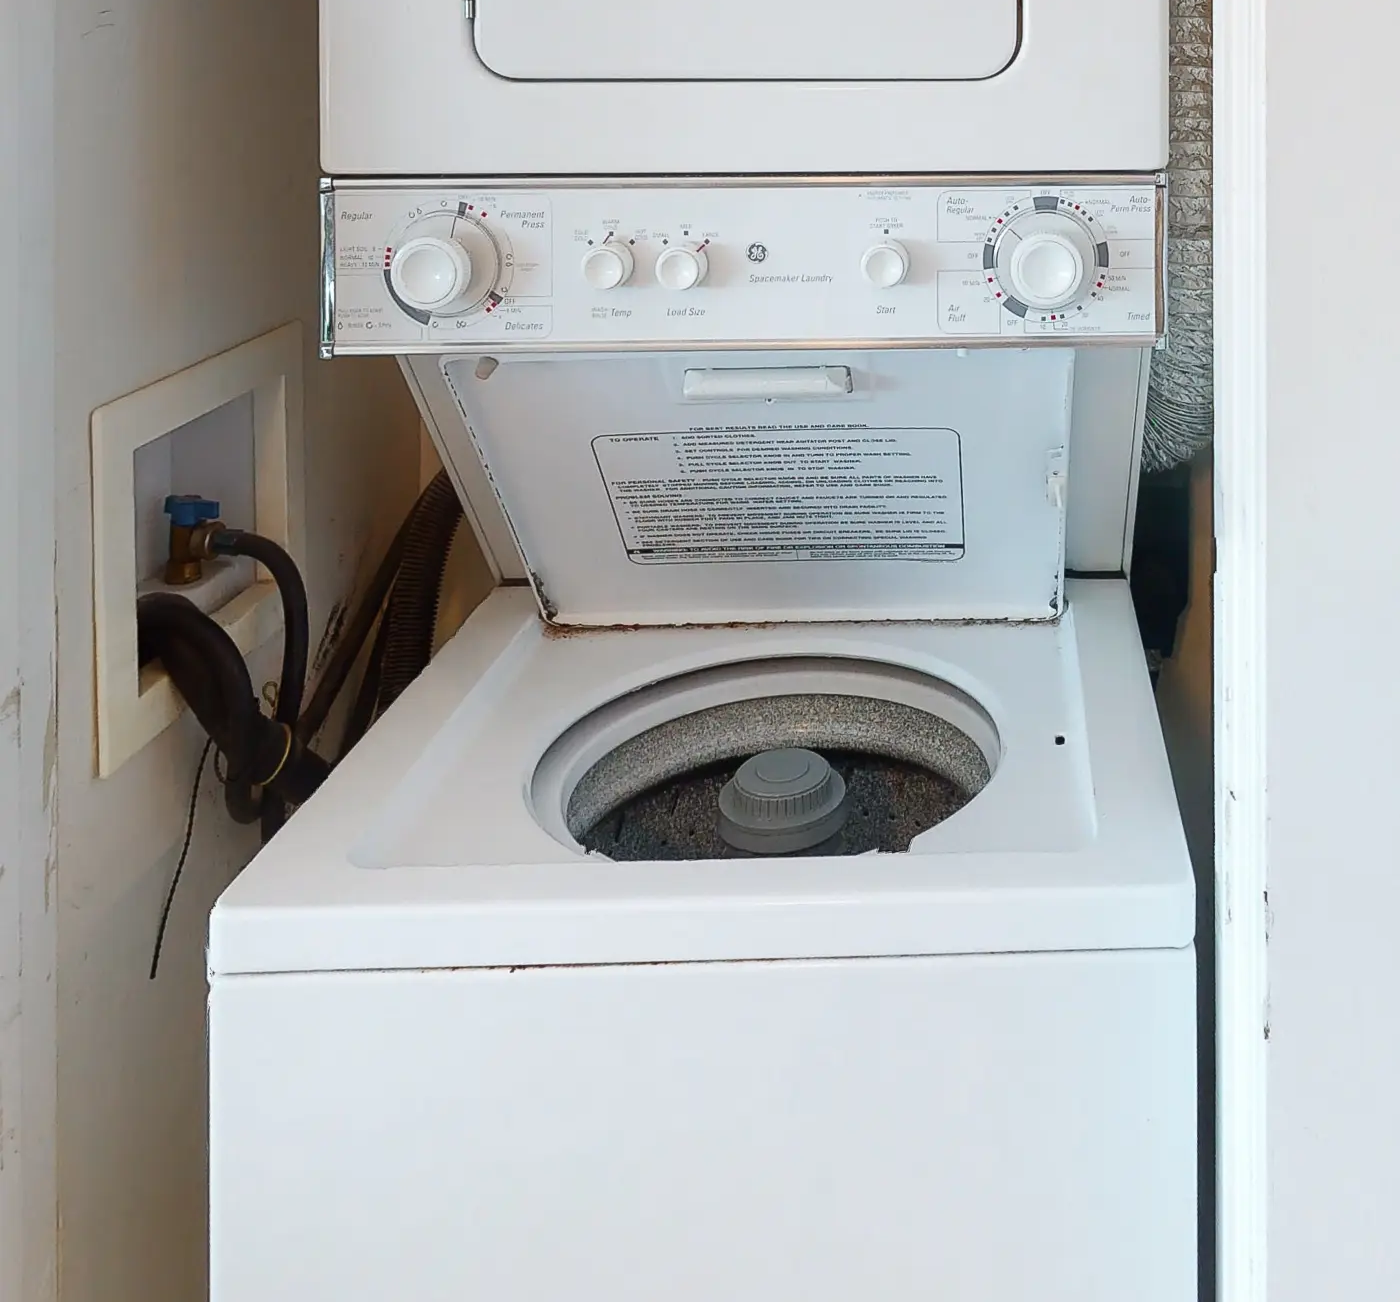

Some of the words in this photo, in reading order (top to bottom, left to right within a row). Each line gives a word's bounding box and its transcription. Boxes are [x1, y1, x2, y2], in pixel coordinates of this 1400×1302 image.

[946, 196, 969, 205] Auto-
[1129, 195, 1151, 204] Auto-
[946, 206, 974, 215] Regular
[1111, 205, 1130, 213] Perm
[1130, 205, 1151, 213] Press
[341, 211, 373, 222] Regular
[500, 210, 544, 219] Permanent
[521, 220, 544, 229] Press
[750, 274, 800, 283] Spacemaker
[801, 274, 833, 283] Laundry
[667, 307, 687, 317] Load
[688, 307, 706, 317] Size
[876, 305, 896, 314] Start
[948, 304, 960, 312] Air
[610, 308, 632, 319] Temp
[948, 314, 966, 322] Fluff
[1127, 312, 1151, 320] Timed
[505, 321, 544, 330] Delicates
